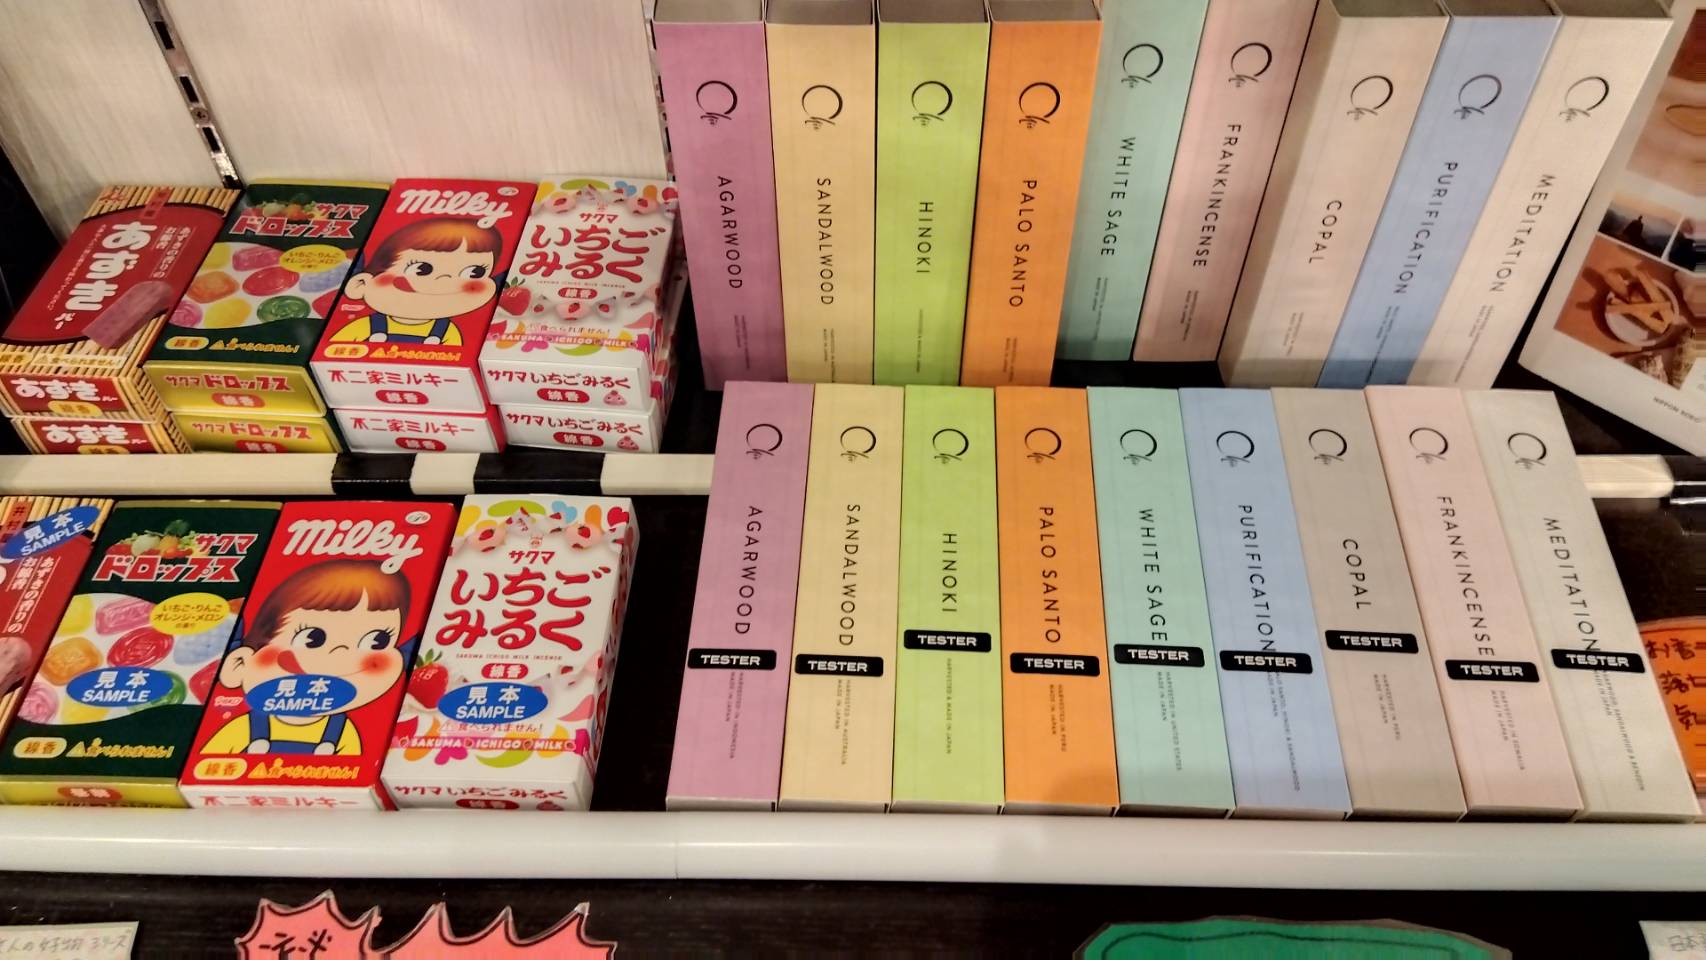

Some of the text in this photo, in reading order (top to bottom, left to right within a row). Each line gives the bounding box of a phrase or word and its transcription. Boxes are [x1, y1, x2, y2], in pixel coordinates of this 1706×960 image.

[396, 189, 513, 229] Milky
[1101, 136, 1136, 257] WHITE SAGE
[1193, 123, 1242, 268] FRANKINCENSE
[315, 202, 369, 219] サクマ
[579, 213, 619, 224] サクマ
[229, 215, 359, 240] ドロップス
[530, 224, 666, 255] いちご
[717, 175, 743, 289] AGARWOOD
[816, 177, 834, 305] SANDALWOOD
[916, 201, 934, 274] HINOKI
[1308, 200, 1343, 265] COPAL
[1393, 161, 1459, 295] PURIFICATION
[1488, 173, 1556, 293] MEDITATION
[1009, 179, 1037, 308] PALO SANTO
[518, 250, 645, 284] みるく
[164, 373, 294, 392] サクマ ドロップス
[327, 369, 459, 388] 不二家ミルキー
[191, 421, 313, 440] サクマ ドロップス
[350, 416, 475, 435] 不二家ミルキー
[20, 521, 85, 556] SAMPLE
[24, 513, 74, 544] 見本
[194, 533, 259, 554] サクマ
[282, 519, 424, 575] Milky
[508, 549, 555, 565] サクマ
[91, 555, 246, 582] ドロップス
[734, 505, 763, 635] AGARWOOD
[838, 504, 861, 647] SANDALWOOD
[942, 533, 957, 612] HINOKI
[1039, 506, 1061, 644] PALO SANTO
[1138, 508, 1168, 642] WHITE SAGE
[1238, 504, 1276, 652] PURIFICATION
[1342, 538, 1372, 610] COPAL
[1437, 496, 1495, 657] FRANKINCENSE
[450, 566, 611, 608] いちご
[1543, 517, 1601, 651] MEDITATION
[435, 608, 586, 651] みるく
[917, 634, 977, 647] TESTER
[1339, 635, 1403, 648] TESTER
[700, 654, 761, 666] TESTER
[807, 660, 868, 672] TESTER
[1023, 658, 1085, 670] TESTER
[1127, 649, 1189, 661] TESTER
[1234, 655, 1297, 667] TESTER
[1566, 653, 1630, 667] TESTER
[94, 670, 150, 689] 見本
[1460, 664, 1524, 677] TESTER
[81, 689, 151, 703] SAMPLE
[274, 677, 330, 698] 見本
[466, 685, 522, 705] 見本
[263, 698, 334, 712] SAMPLE
[456, 706, 526, 719] SAMPLE
[410, 737, 564, 750] SAKUMA ICHIGO MILK
